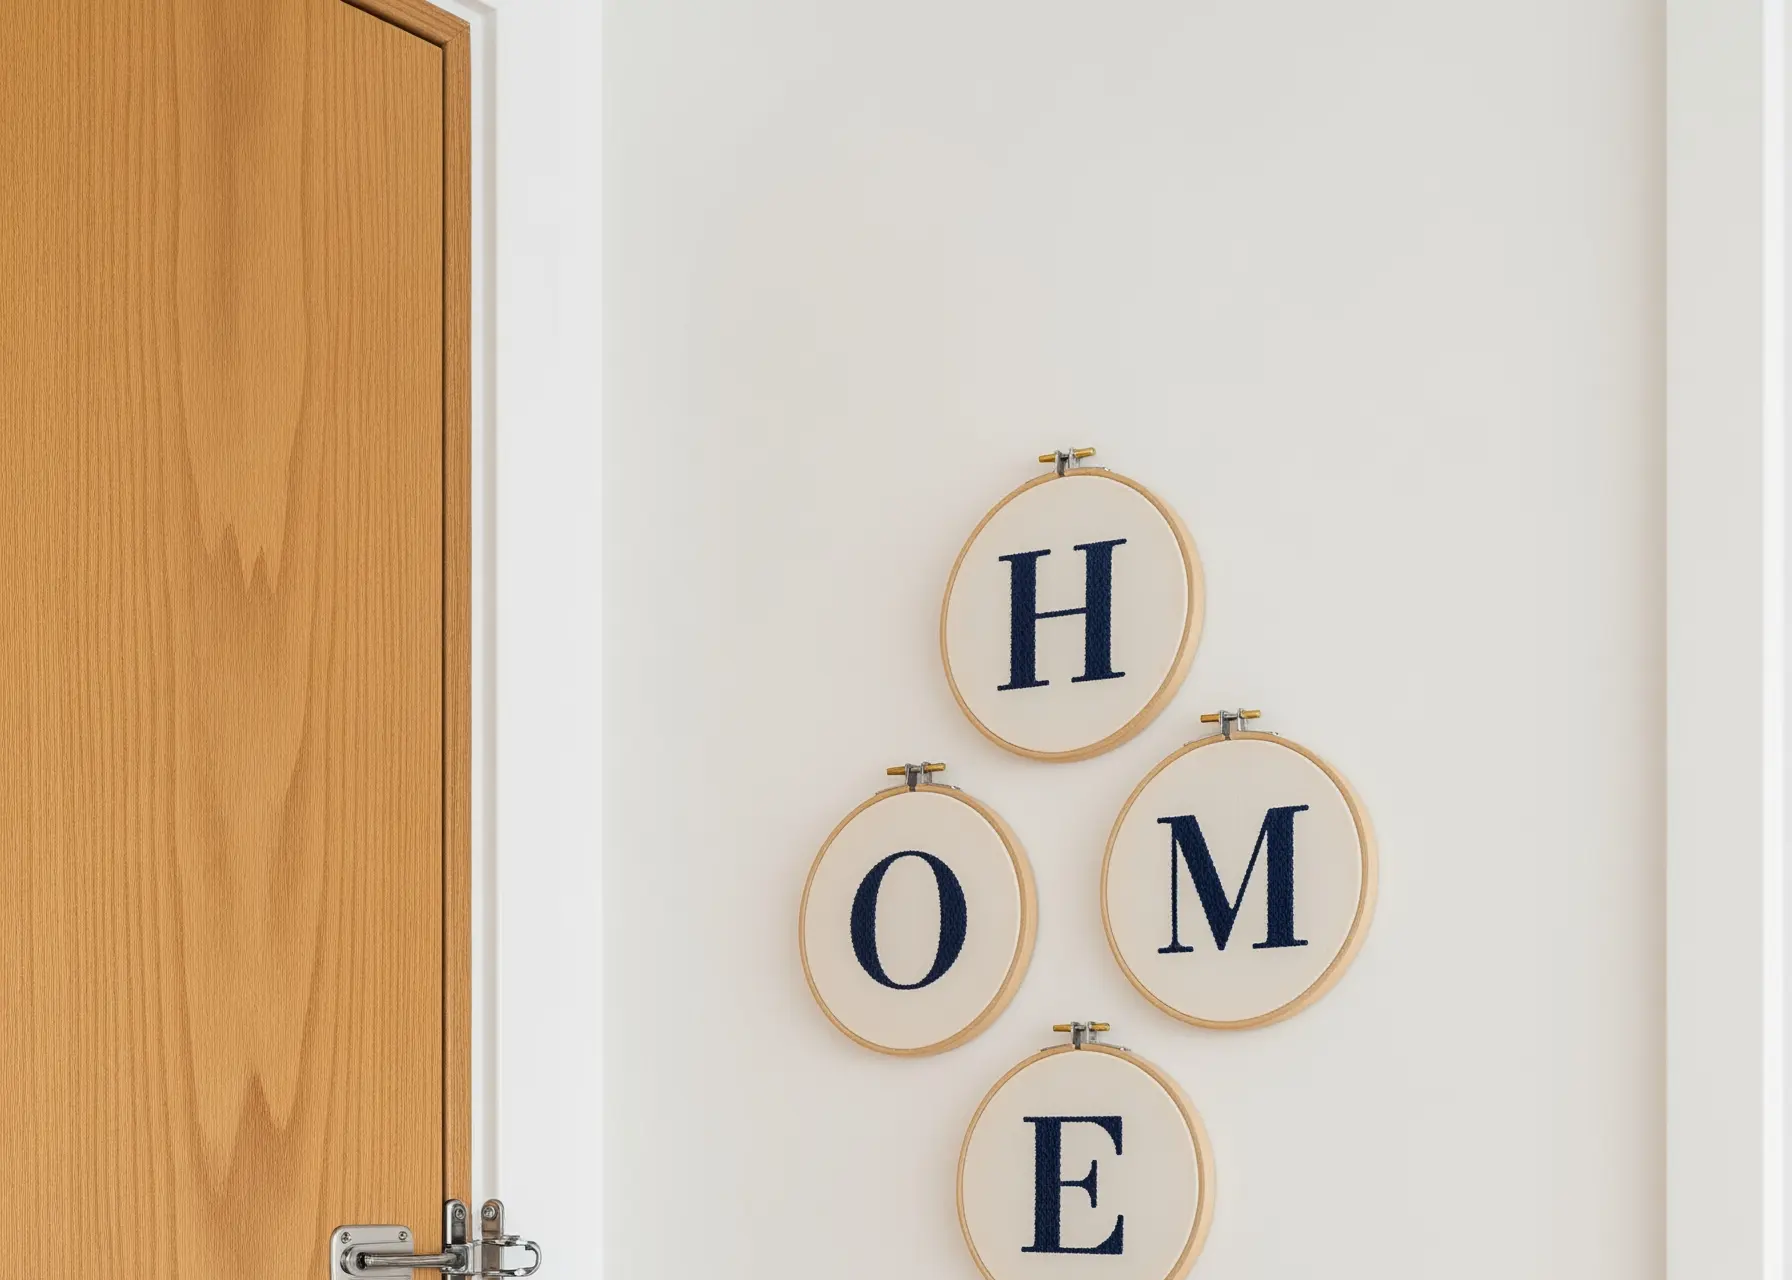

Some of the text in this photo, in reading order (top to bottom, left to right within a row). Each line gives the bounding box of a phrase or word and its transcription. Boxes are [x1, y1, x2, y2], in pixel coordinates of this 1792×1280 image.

[997, 538, 1128, 692] H
[849, 849, 968, 991] O
[1156, 804, 1310, 955] M
[1020, 1115, 1124, 1255] E
